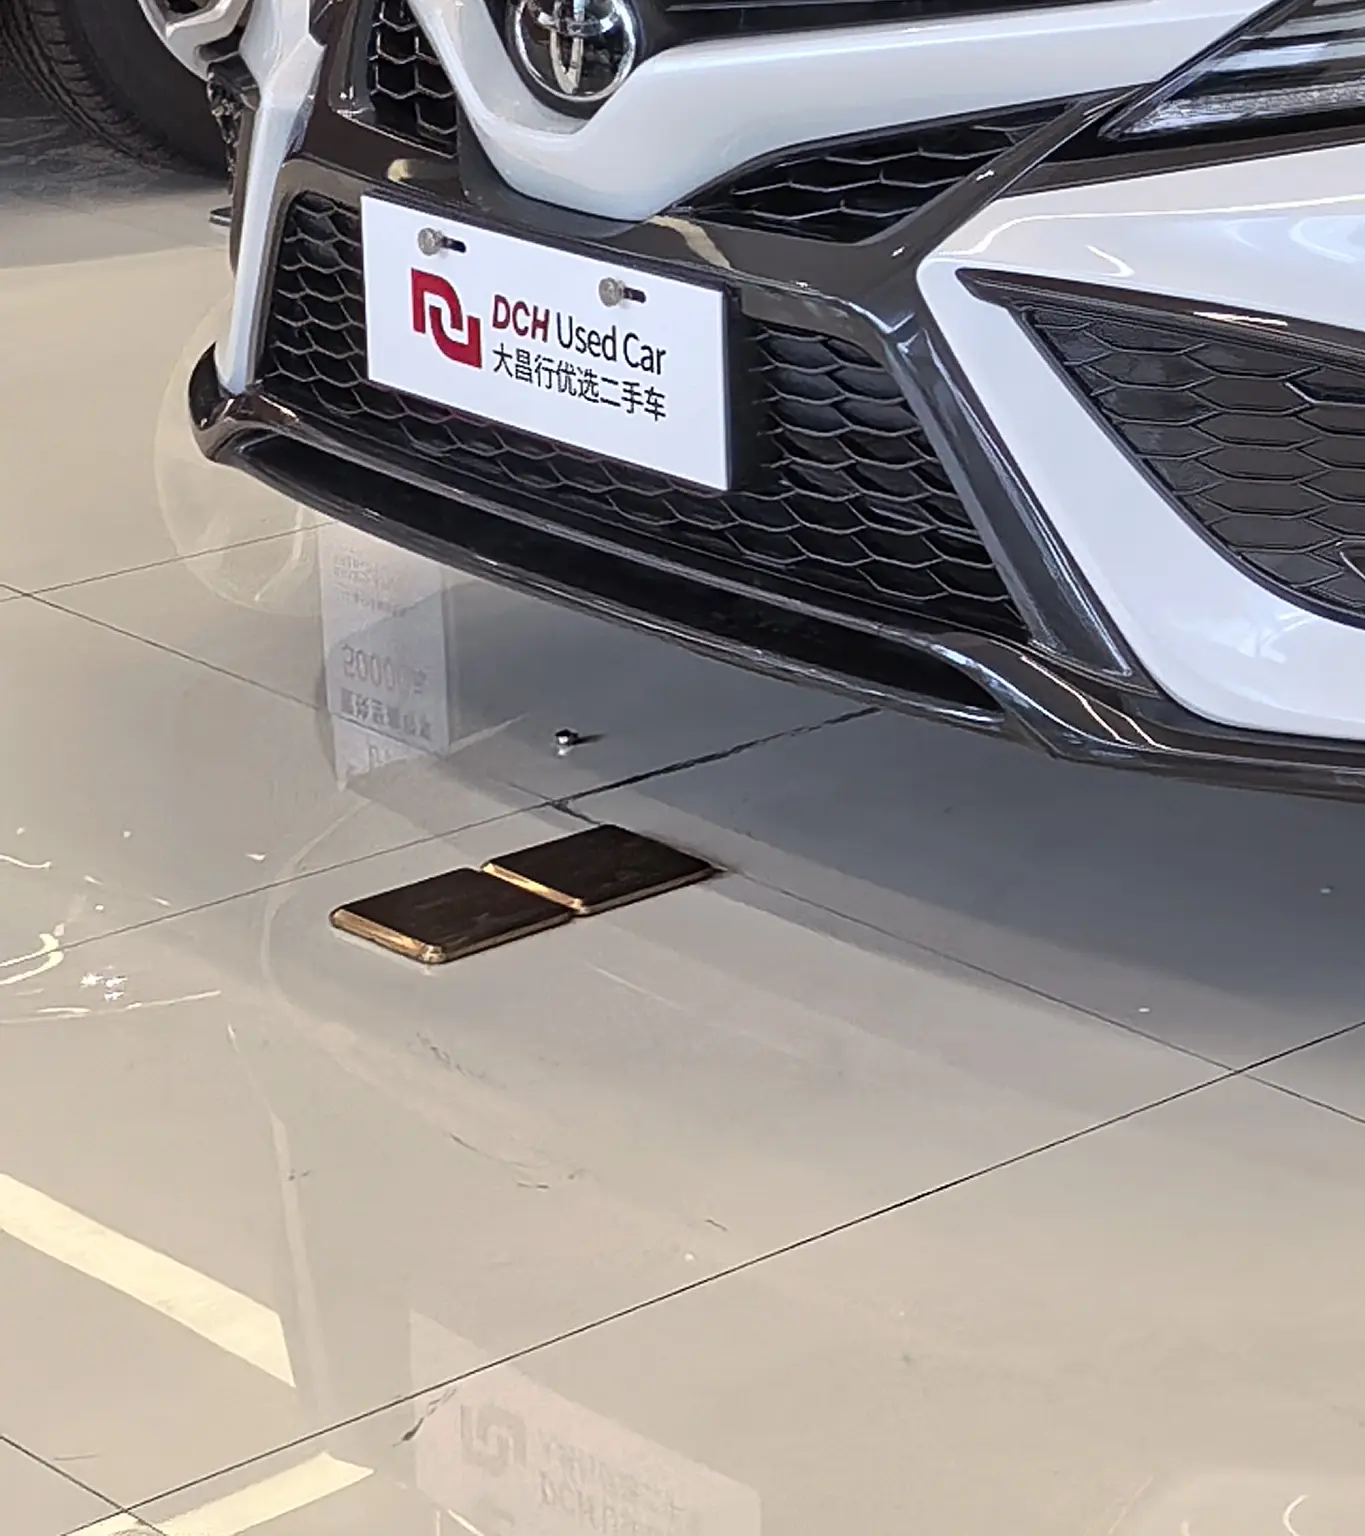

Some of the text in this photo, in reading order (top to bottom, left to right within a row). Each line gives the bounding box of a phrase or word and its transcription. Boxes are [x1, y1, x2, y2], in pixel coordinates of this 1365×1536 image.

[491, 294, 667, 376] DCH Used Car
[492, 343, 667, 422] 大昌行优选二手车
